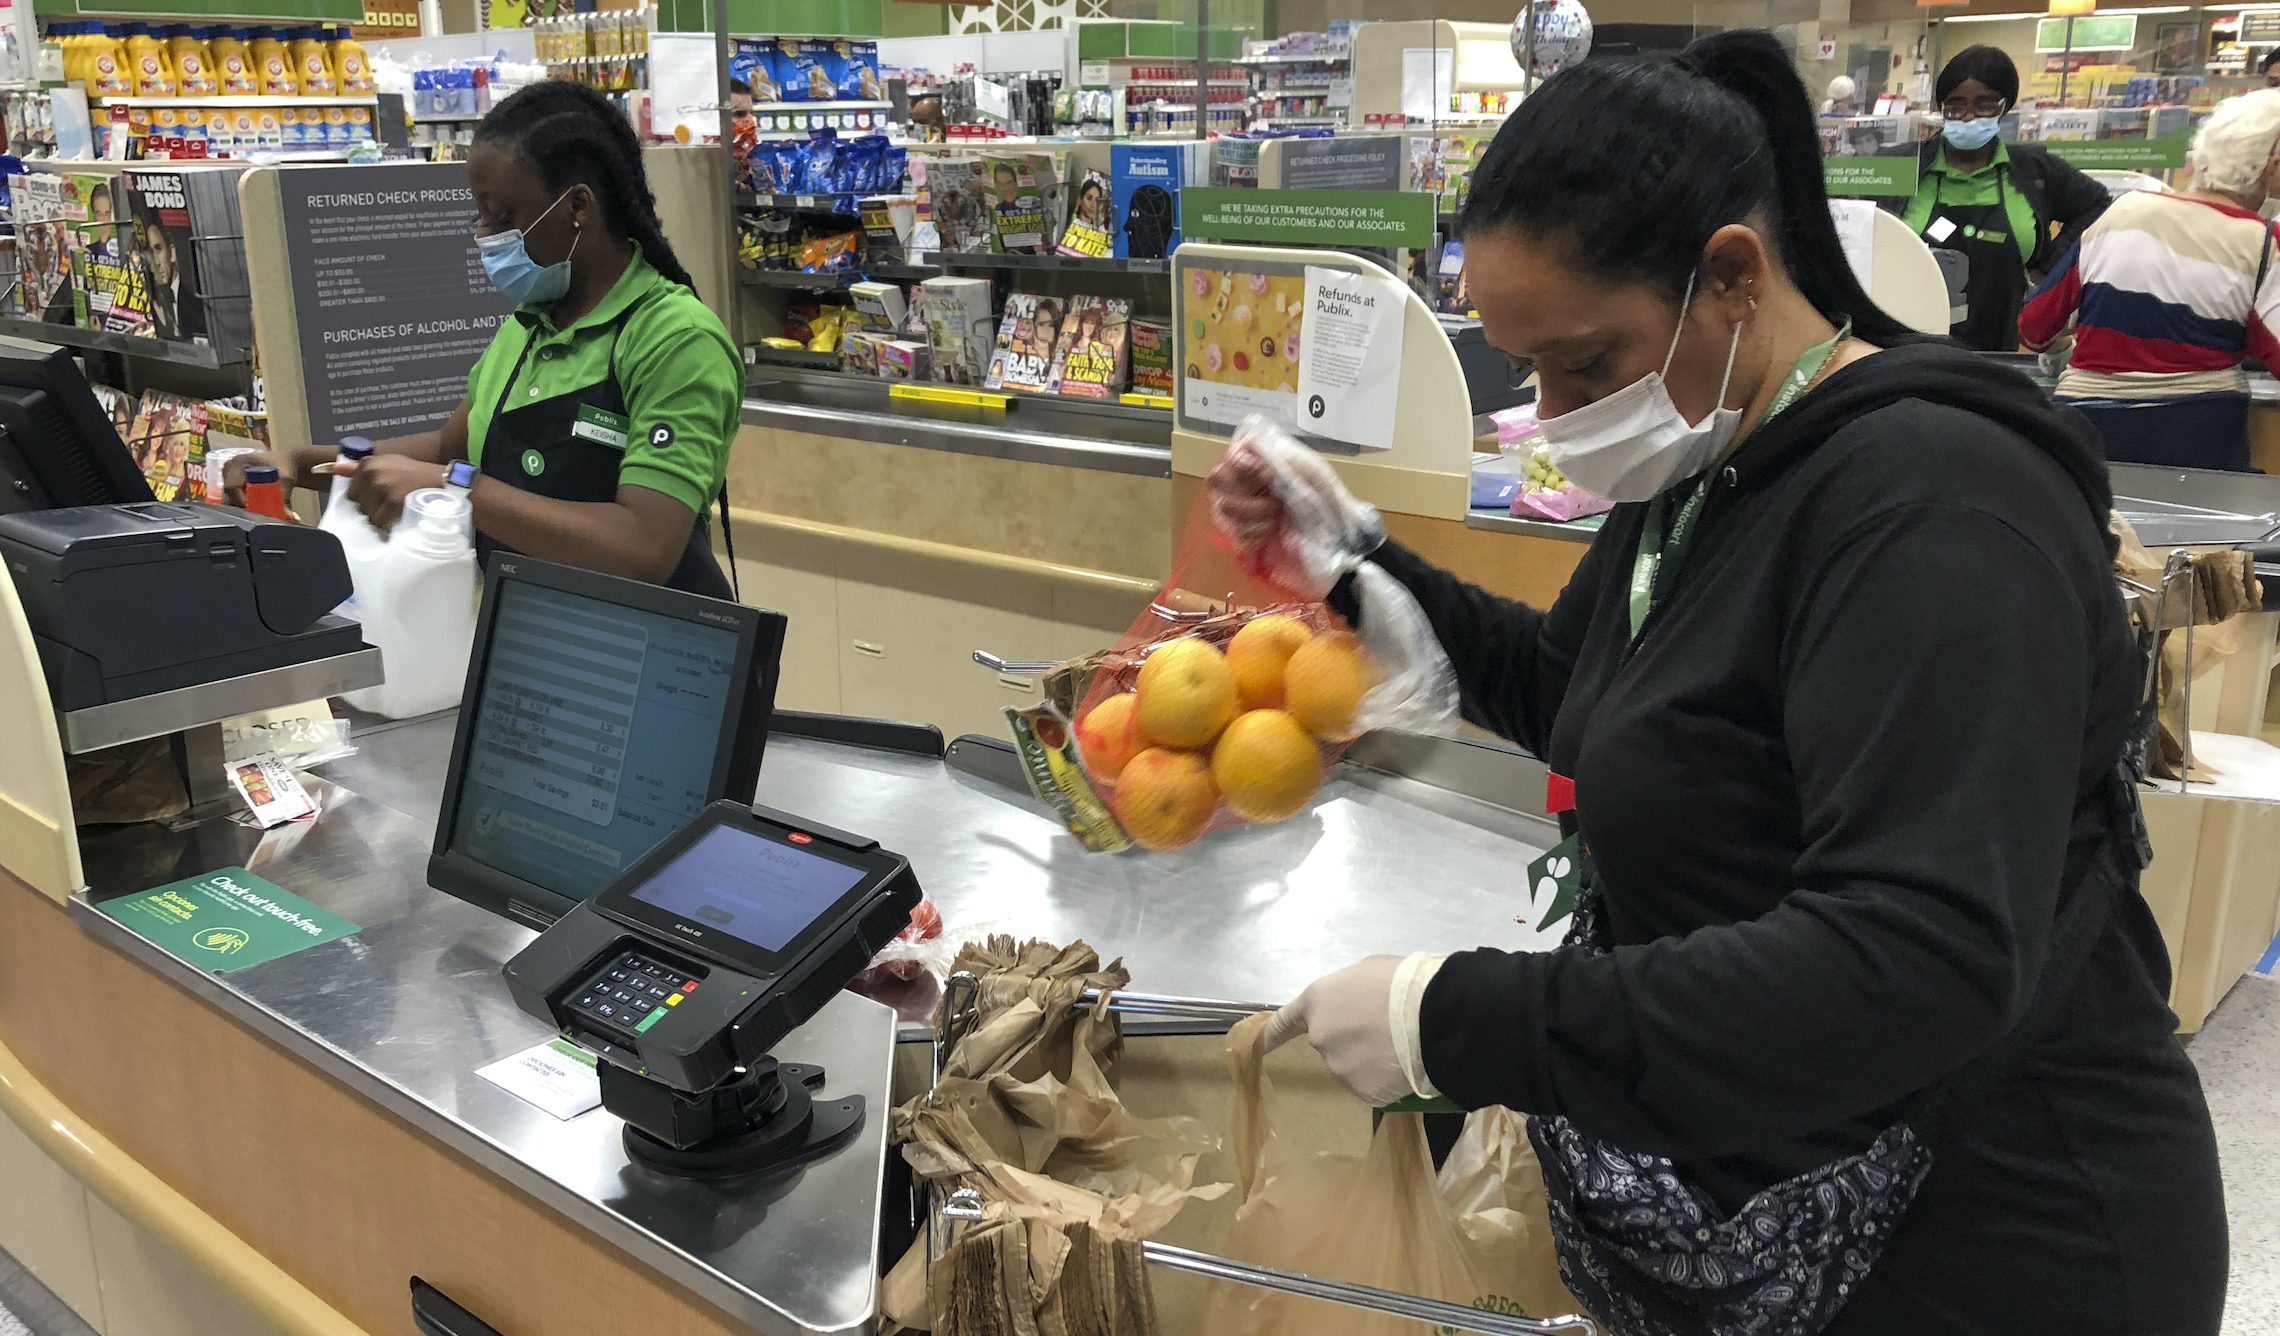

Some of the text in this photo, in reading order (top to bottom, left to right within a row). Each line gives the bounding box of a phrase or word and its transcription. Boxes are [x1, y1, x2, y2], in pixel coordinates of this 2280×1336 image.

[1290, 152, 1386, 166] RETURNED CHECK PROCESSING POLICY
[1129, 164, 1169, 176] Autism
[136, 175, 182, 192] JAMES
[145, 191, 185, 209] BOND
[307, 188, 475, 208] RETURNED CHECK PROCESS
[1220, 203, 1385, 218] WE'RE TAKING EXTRA PRECAUTIONS FOR THE
[1202, 214, 1407, 231] WELL-BEING OF OUR CUSTOMERS AND OUR ASSOCIATES.
[1061, 232, 1108, 258] TO KATE!
[331, 256, 356, 264] AMOUNT
[366, 254, 386, 262] CHECK
[319, 298, 346, 307] GREATER
[1318, 285, 1375, 307] Refunds at
[1106, 300, 1129, 314] Style
[1317, 299, 1353, 317] Publix.
[324, 315, 496, 343] PURCHASES OF ALCOHOL AND
[1007, 352, 1048, 373] BABY
[1133, 364, 1163, 377] DROP
[1066, 368, 1073, 380] &
[334, 425, 343, 433] THE
[344, 423, 355, 432] LAW
[356, 420, 380, 430] PROHIBITS
[380, 419, 389, 427] THE
[389, 417, 400, 426] SALE
[408, 414, 428, 423] ALCOHOL
[428, 411, 451, 421] PRODUCTS
[594, 412, 619, 426] Publix
[590, 428, 618, 443] KEISHA
[1669, 493, 1700, 546] instacart
[500, 562, 518, 575] NEC
[269, 757, 286, 773] SAVE
[531, 777, 547, 789] Total
[616, 806, 656, 827] Balance Due
[758, 848, 801, 869] Publix
[162, 890, 200, 911] Opciones
[210, 876, 249, 898] Check
[242, 890, 270, 908] out
[261, 899, 324, 938] touch-free.
[158, 899, 193, 920] contacto
[627, 957, 634, 965] 1
[645, 965, 654, 973] 2
[664, 973, 673, 981] 3
